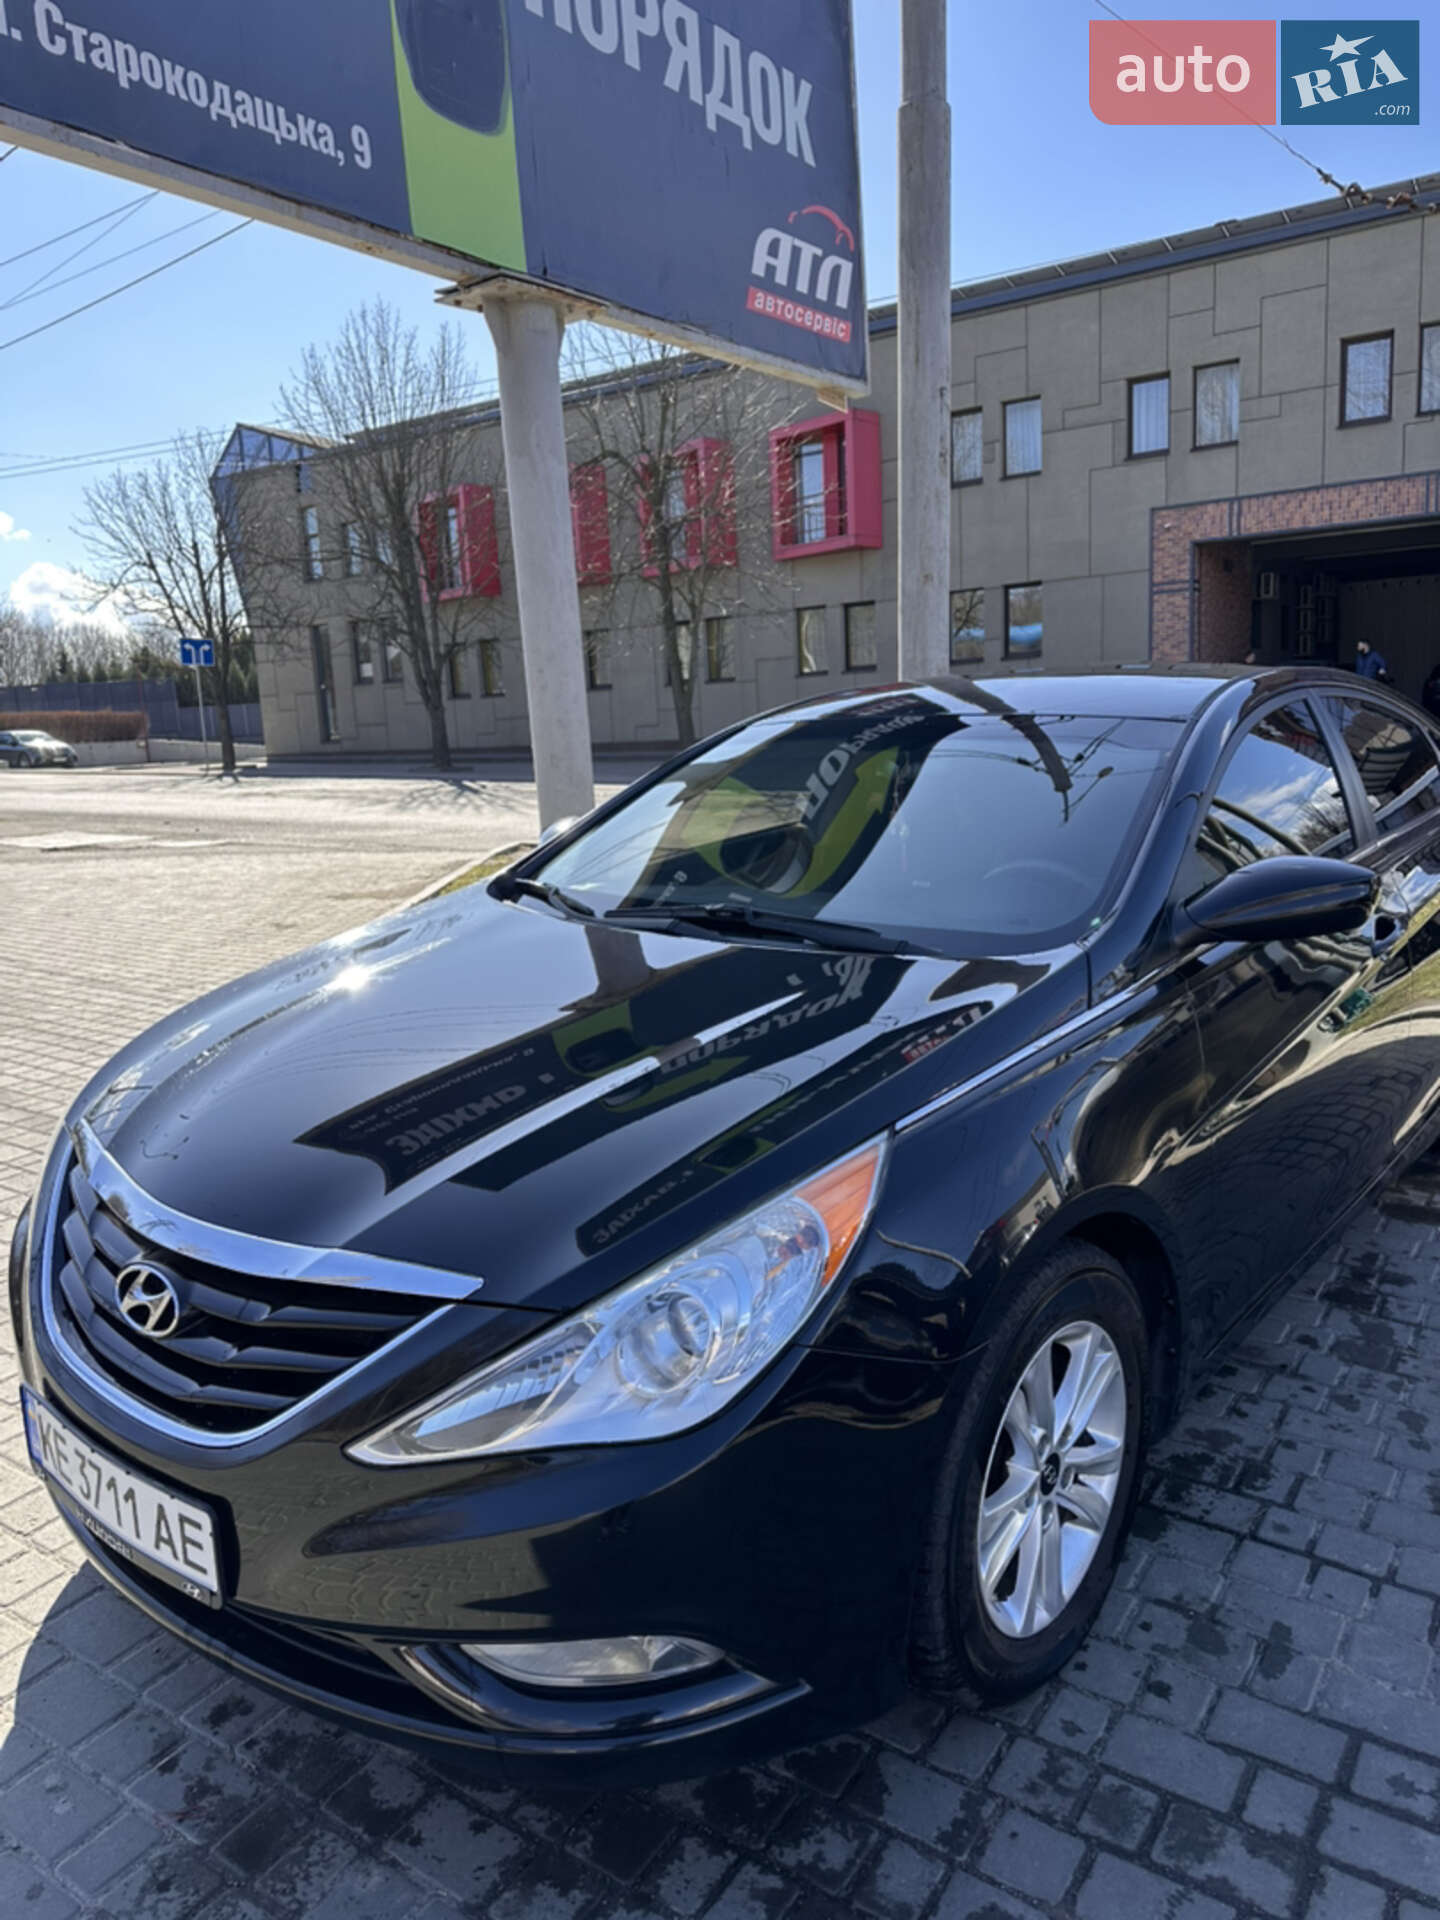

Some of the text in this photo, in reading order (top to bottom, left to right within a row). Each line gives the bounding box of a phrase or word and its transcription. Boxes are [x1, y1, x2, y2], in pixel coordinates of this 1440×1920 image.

[34, 0, 373, 170] Старокодацька, 9
[524, 0, 816, 168] ОРЯДОК
[753, 291, 848, 339] автосервіс
[74, 1448, 141, 1541] 3711
